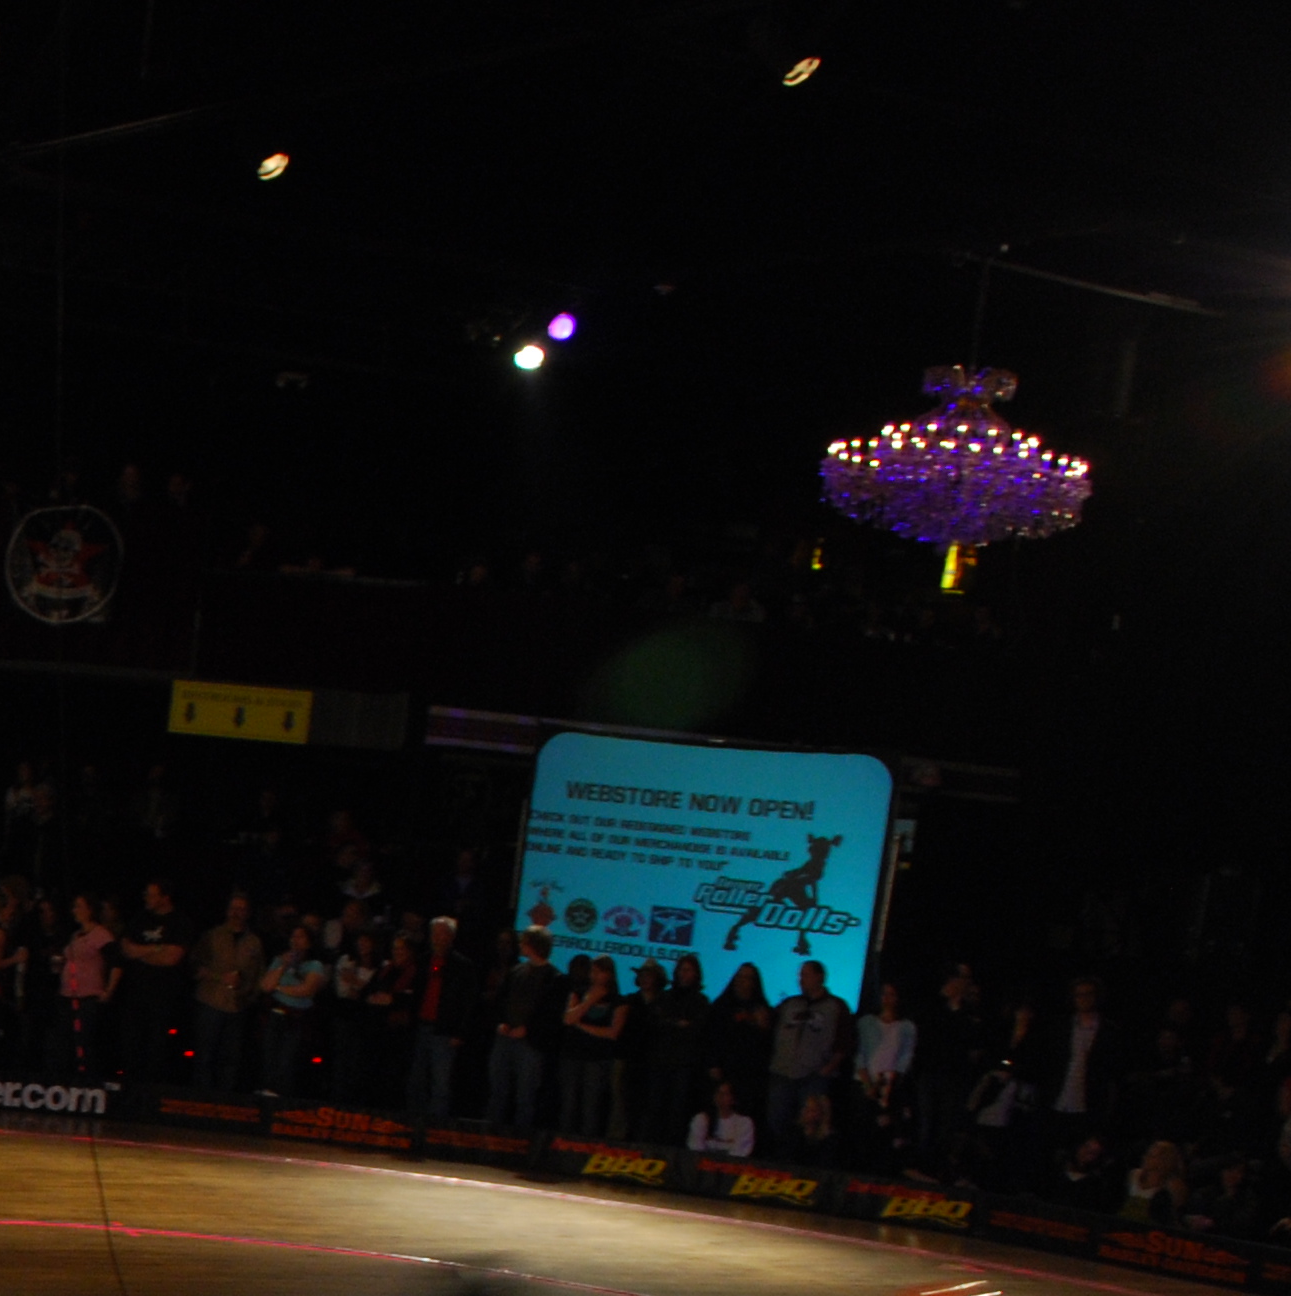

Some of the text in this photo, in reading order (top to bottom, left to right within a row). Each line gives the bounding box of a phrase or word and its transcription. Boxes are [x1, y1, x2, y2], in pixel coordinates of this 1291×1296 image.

[567, 781, 815, 821] WEBSTORE NOW OPEN!
[694, 883, 849, 935] Roller Dolls
[582, 1153, 667, 1180] BBQ
[730, 1173, 818, 1200] BBQ
[881, 1195, 974, 1223] BBQ
